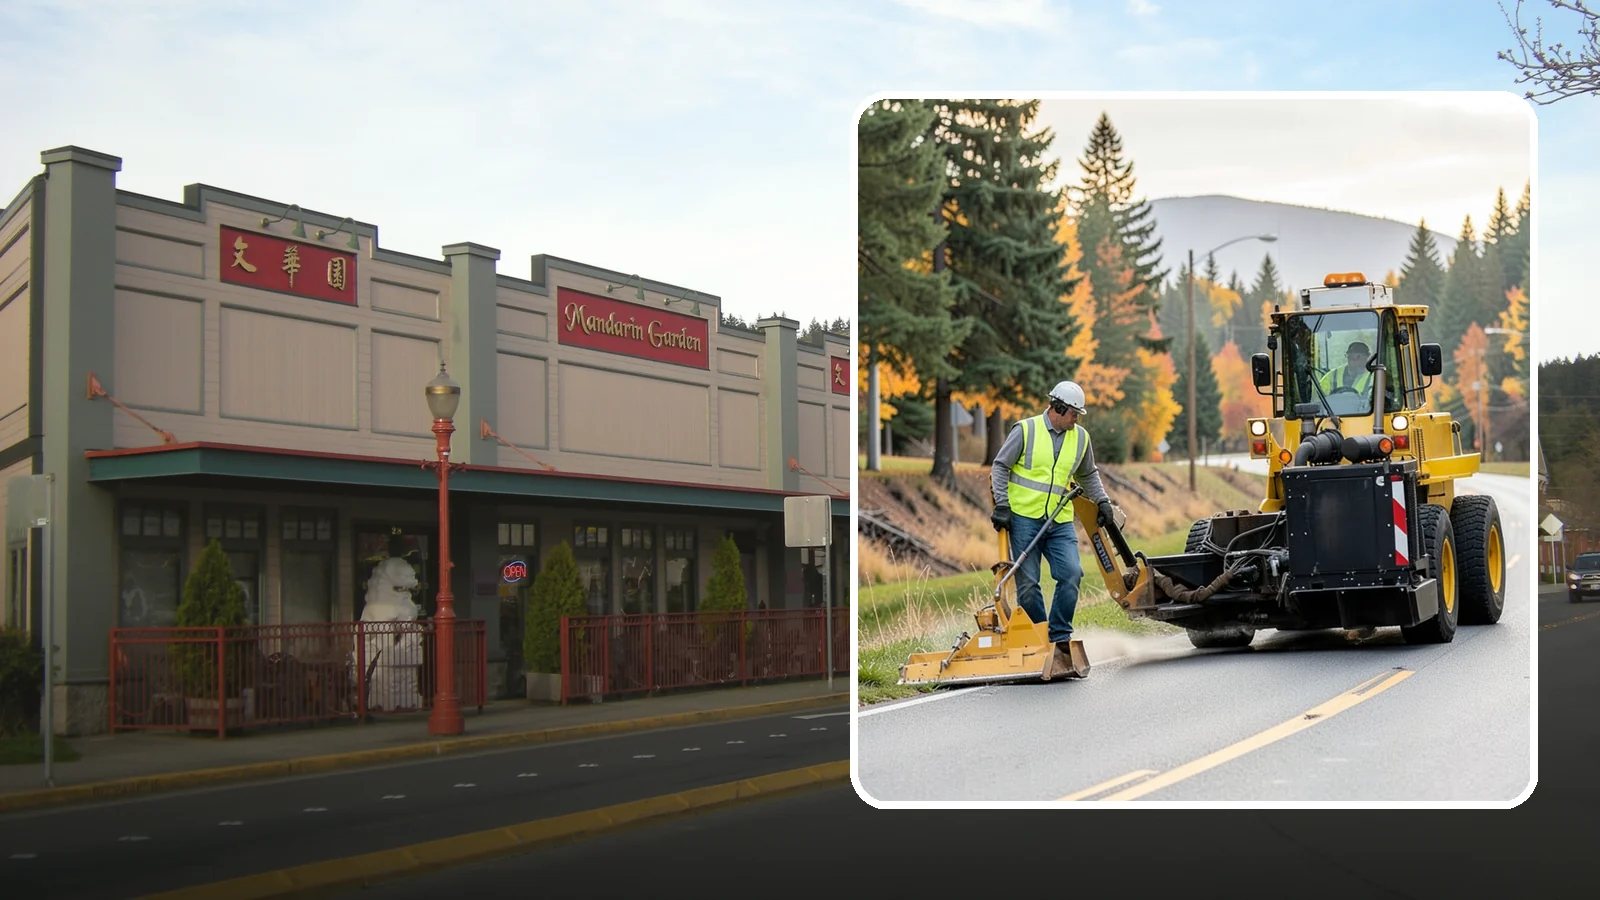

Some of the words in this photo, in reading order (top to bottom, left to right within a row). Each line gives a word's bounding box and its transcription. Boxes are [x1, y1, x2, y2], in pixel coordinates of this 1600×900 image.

[230, 236, 347, 291] 文華園
[564, 302, 645, 341] Mandarin
[647, 320, 702, 352] Garden
[503, 565, 527, 578] OPEN
